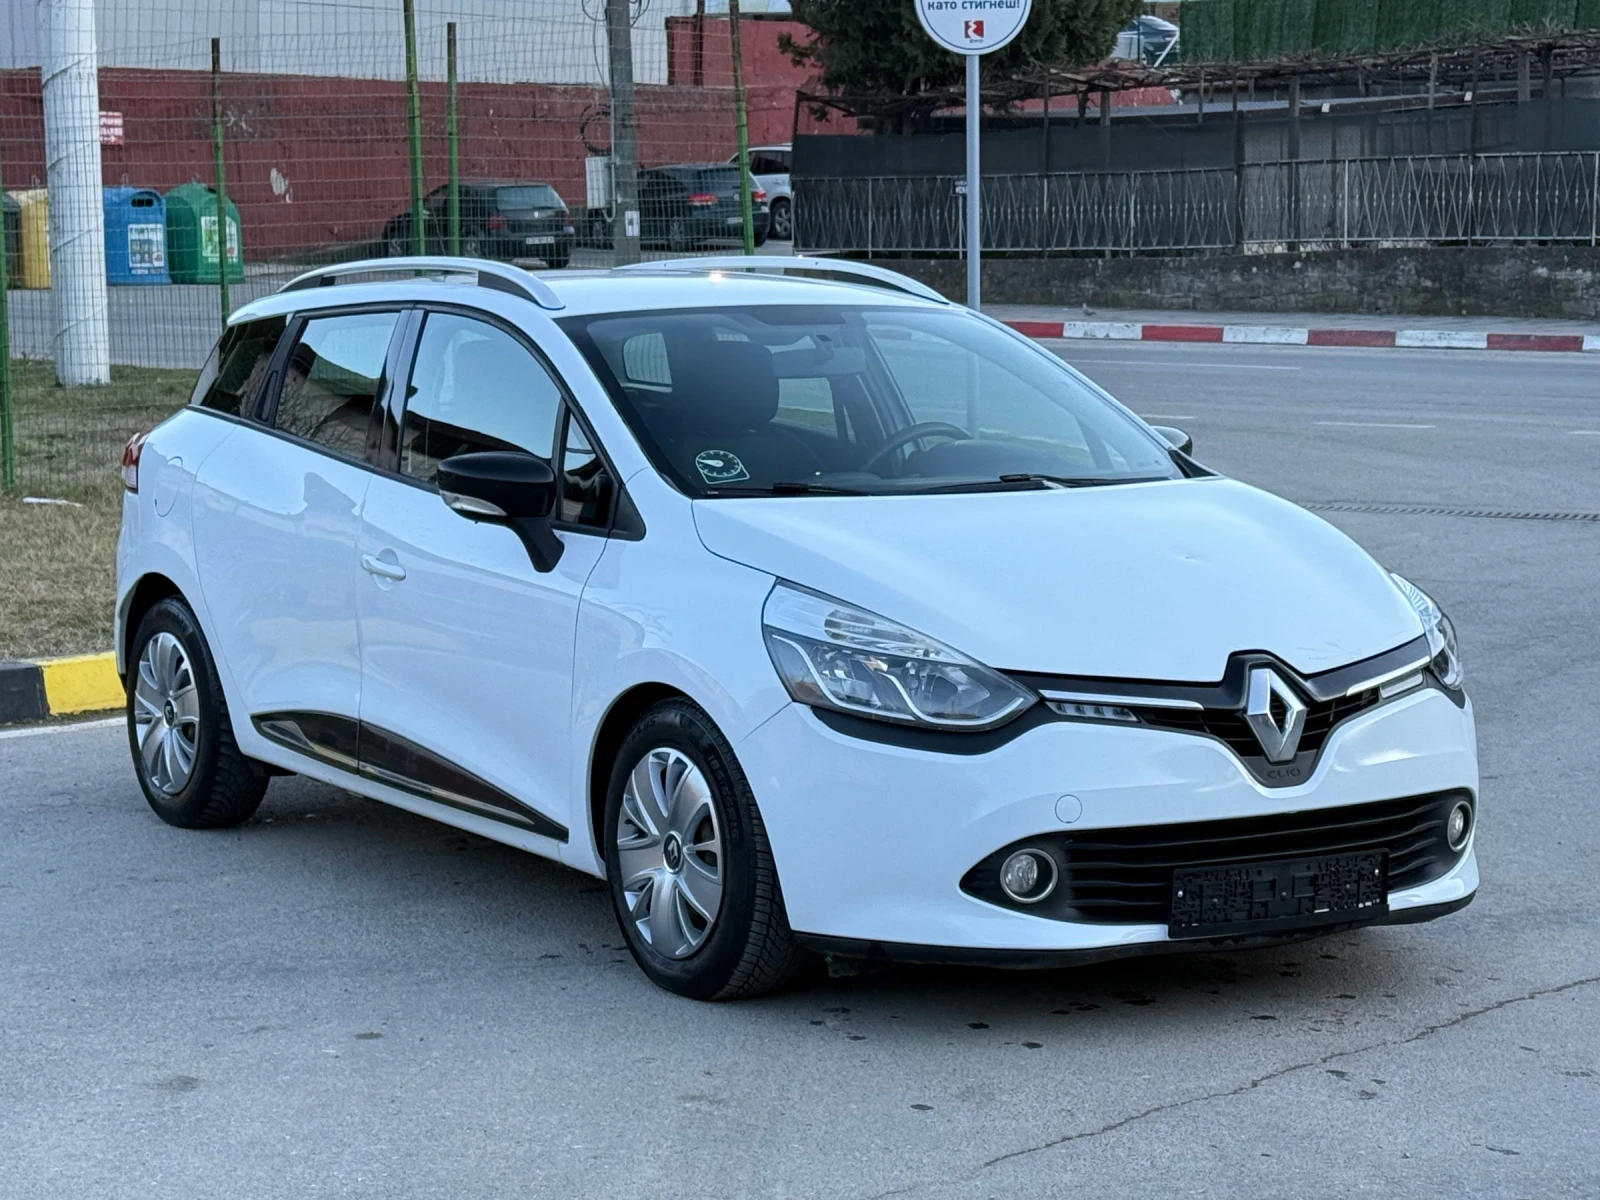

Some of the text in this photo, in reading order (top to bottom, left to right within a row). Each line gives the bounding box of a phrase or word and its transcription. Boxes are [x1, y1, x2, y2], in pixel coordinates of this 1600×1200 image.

[927, 0, 1020, 10] като стигнеш!
[1267, 768, 1301, 779] CLIO
